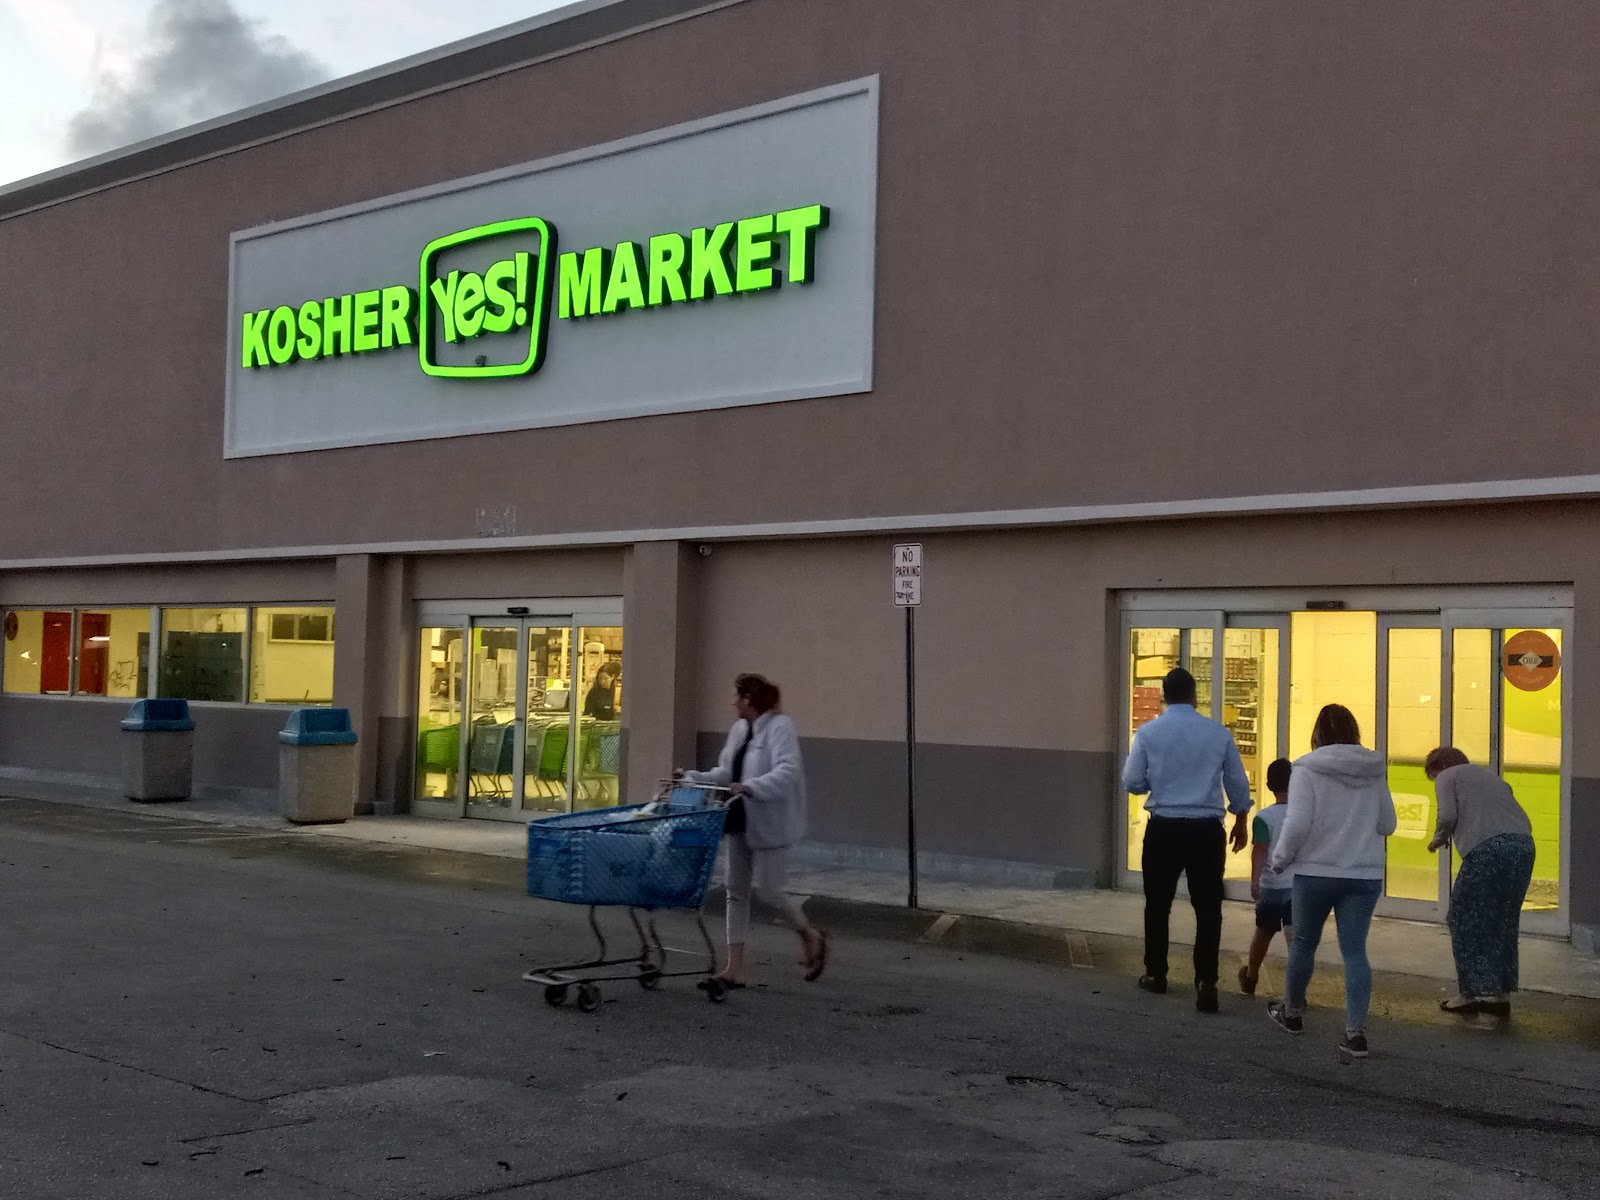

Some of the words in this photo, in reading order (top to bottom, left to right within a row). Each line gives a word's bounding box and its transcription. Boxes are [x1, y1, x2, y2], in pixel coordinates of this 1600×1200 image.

[242, 285, 412, 369] KOSHER
[558, 204, 822, 319] MARKET
[902, 551, 914, 563] NO
[895, 565, 920, 577] PARKING
[902, 580, 914, 589] FIRE
[1395, 804, 1423, 821] es!
